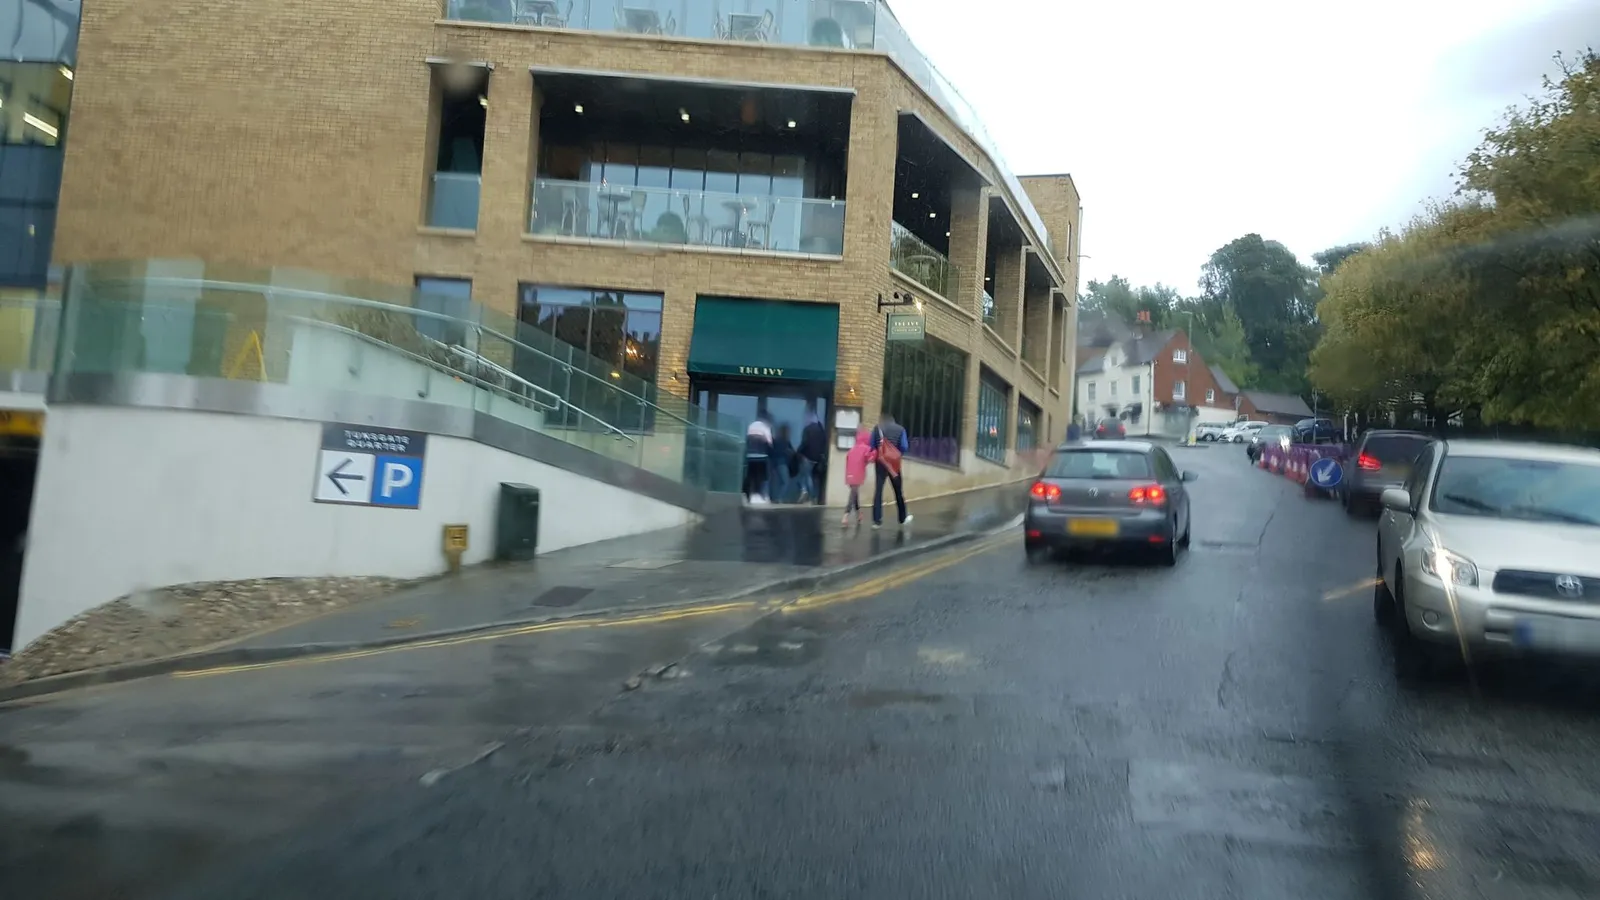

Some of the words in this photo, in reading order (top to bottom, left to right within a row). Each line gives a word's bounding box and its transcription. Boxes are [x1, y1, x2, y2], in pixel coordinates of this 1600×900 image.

[739, 366, 759, 375] THE
[763, 367, 784, 376] IVY
[346, 439, 406, 452] QUARTER
[381, 462, 414, 498] P
